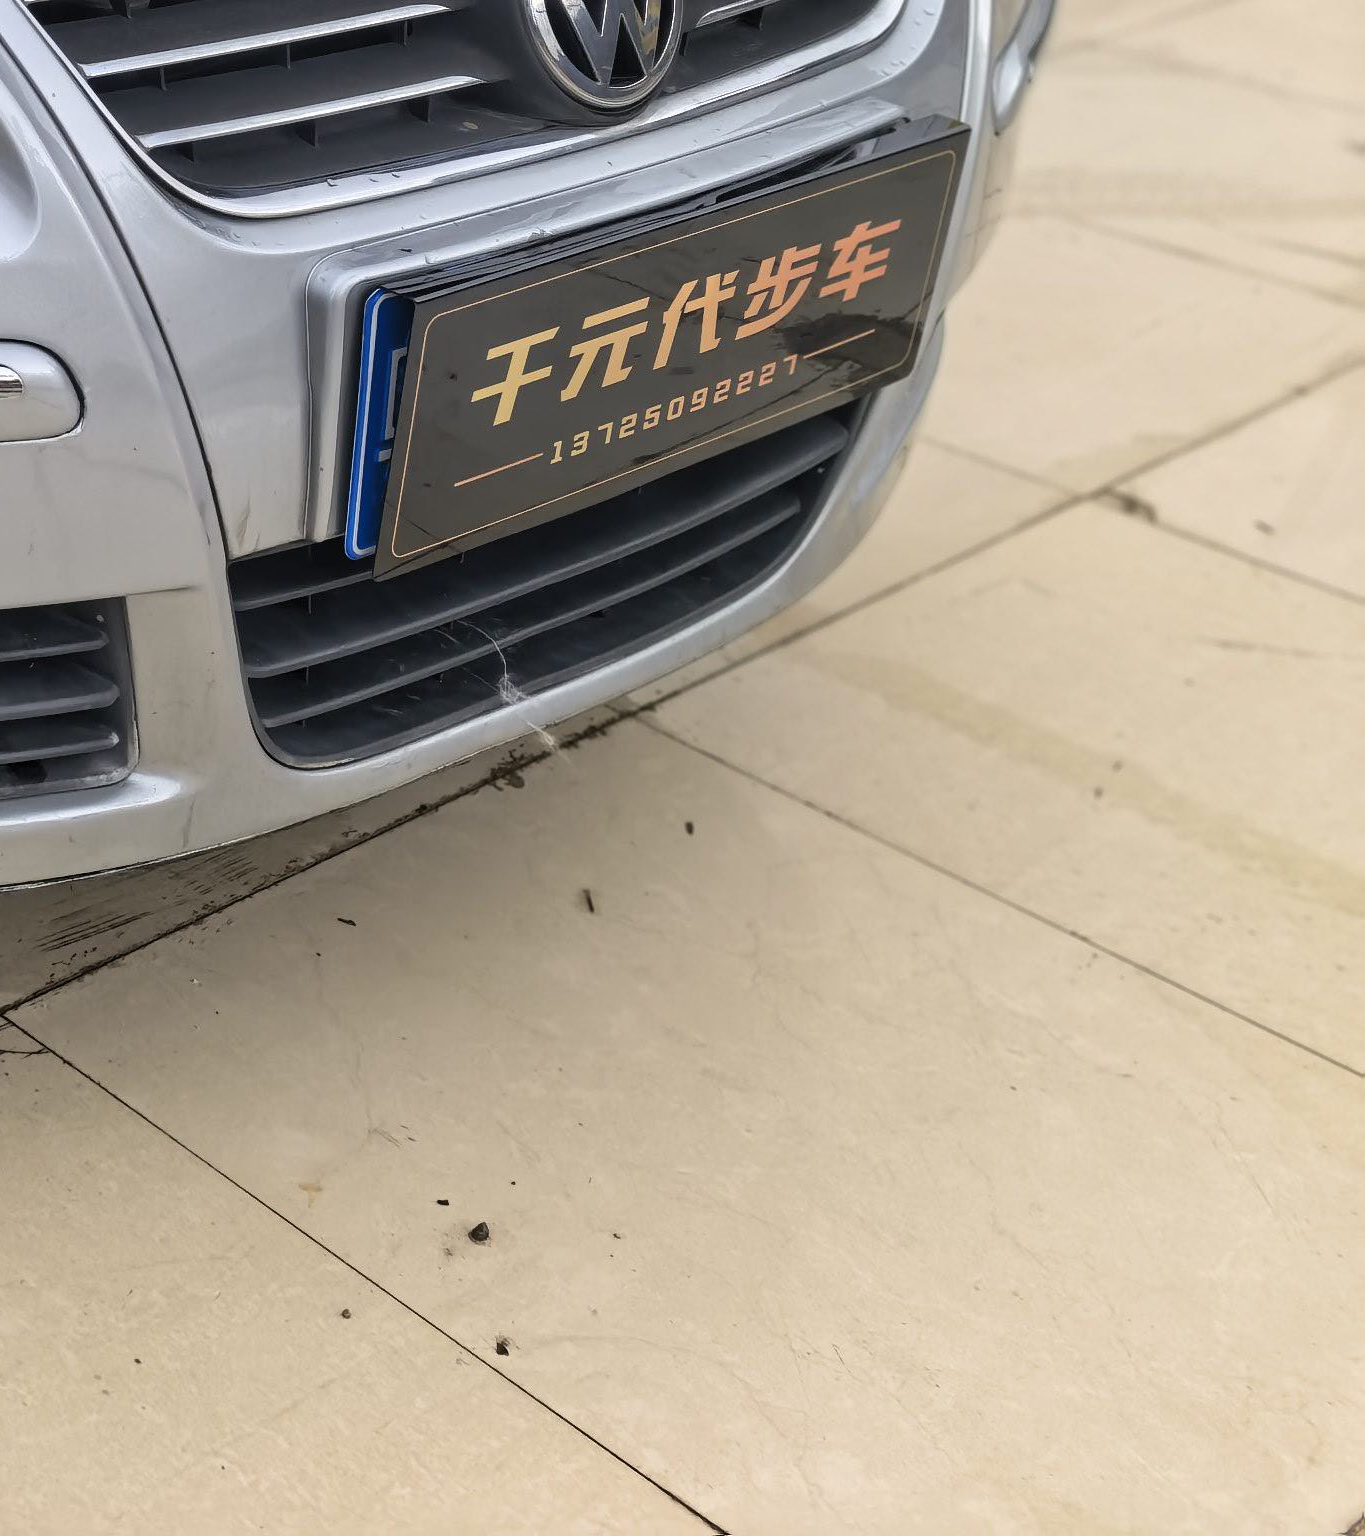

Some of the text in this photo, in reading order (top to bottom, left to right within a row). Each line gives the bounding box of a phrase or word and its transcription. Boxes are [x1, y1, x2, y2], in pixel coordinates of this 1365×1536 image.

[471, 220, 902, 426] 千元代步车
[549, 354, 798, 465] 13725092227
